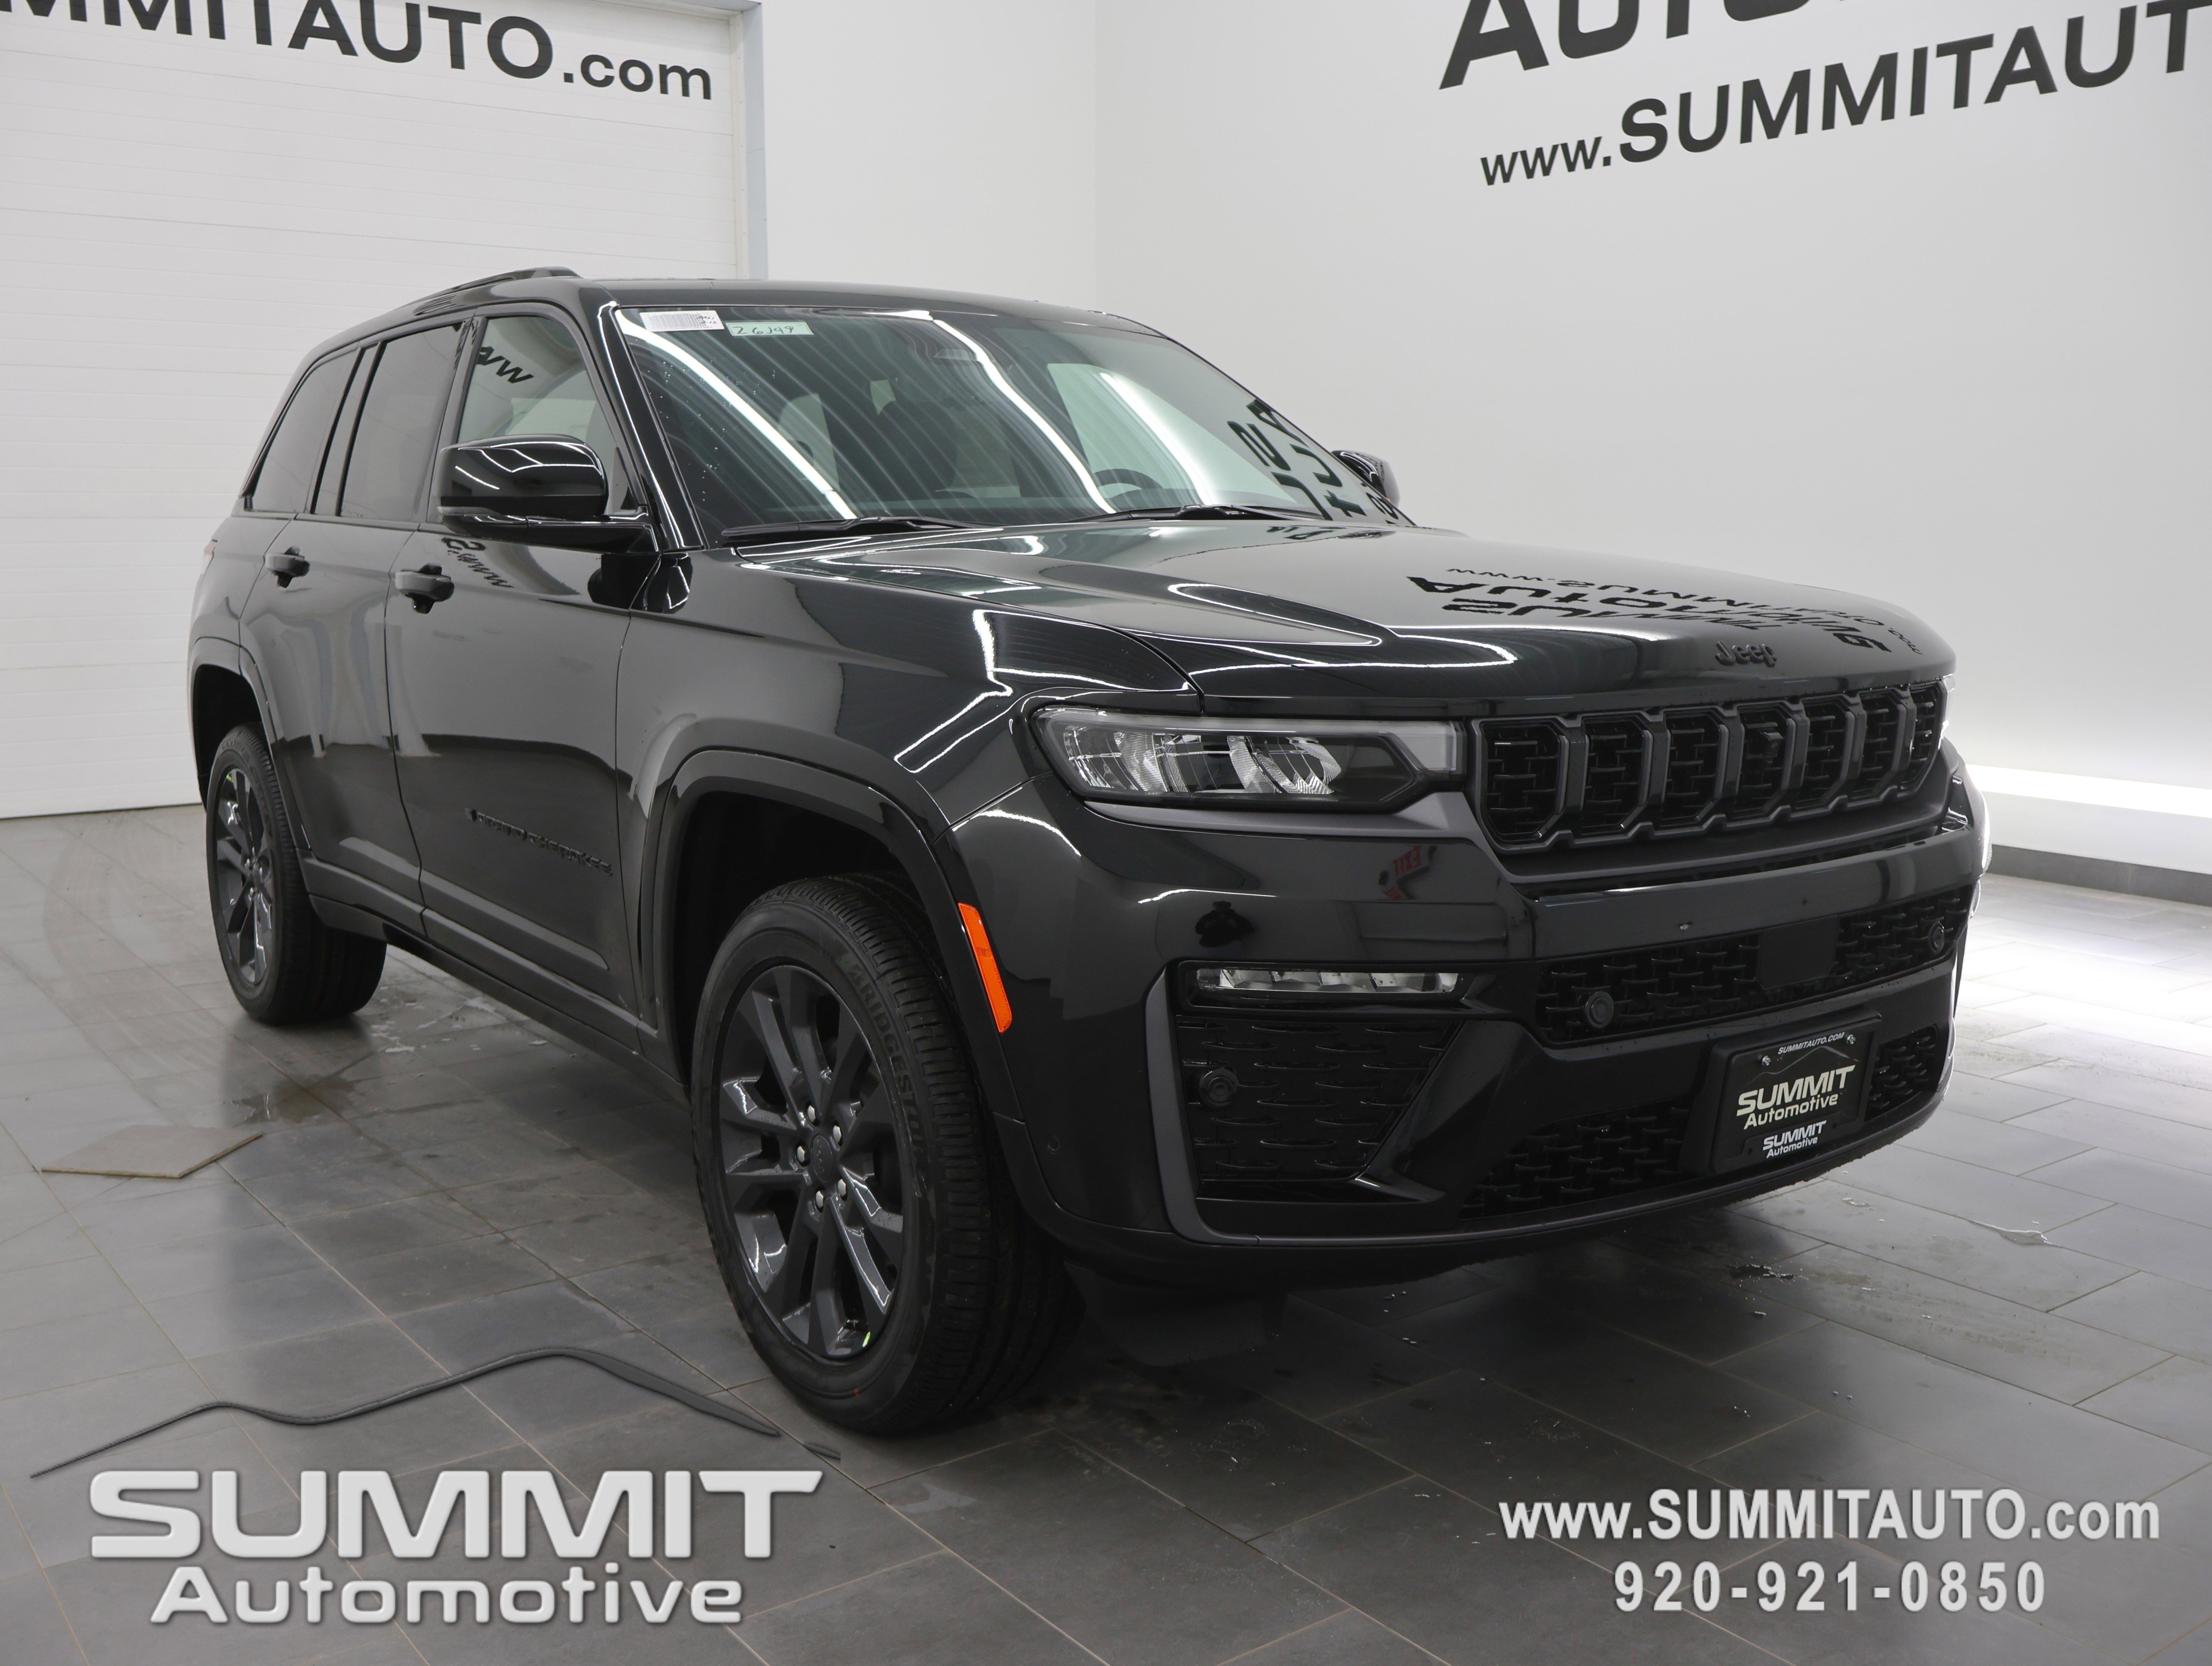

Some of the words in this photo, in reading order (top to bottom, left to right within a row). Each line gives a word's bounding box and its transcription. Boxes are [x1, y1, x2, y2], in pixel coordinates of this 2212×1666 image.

[1715, 641, 1777, 668] Jeep
[1777, 1032, 1845, 1055] SUMMITAUTO.COM
[1736, 1065, 1856, 1117] SUMMIT
[1743, 1093, 1839, 1130] Automotive
[1762, 1120, 1827, 1151] SUMMIT
[1766, 1136, 1818, 1158] Automotive
